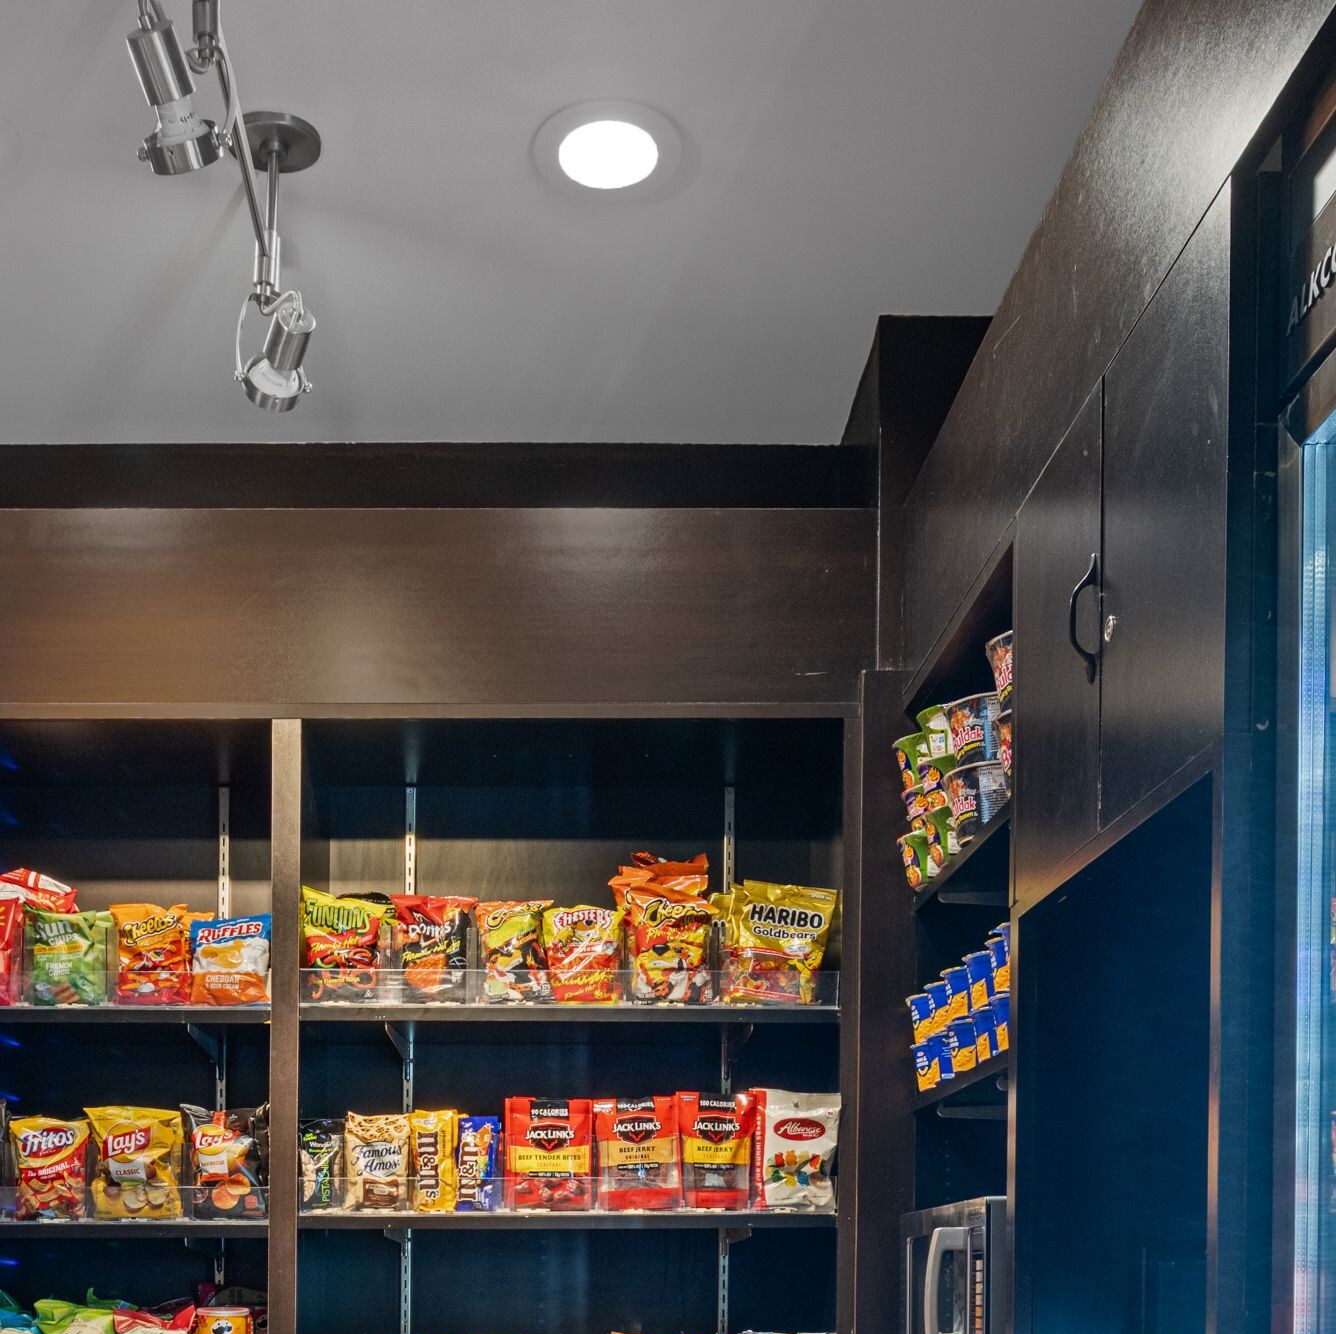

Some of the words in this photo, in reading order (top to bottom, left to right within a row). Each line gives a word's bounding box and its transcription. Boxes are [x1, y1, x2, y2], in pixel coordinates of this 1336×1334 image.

[304, 898, 371, 935] FUNYUNS
[750, 903, 824, 929] HARIBO
[35, 920, 73, 942] Sun
[123, 914, 176, 947] Cheetos
[197, 922, 262, 943] RUFFLES
[753, 926, 817, 940] Goldbears
[45, 962, 72, 970] FRENCH
[206, 975, 240, 983] CHEDDAR
[612, 1123, 635, 1133] JACK
[692, 1121, 714, 1131] JACK
[21, 1129, 74, 1157] Fritos
[107, 1129, 145, 1157] Lay's
[525, 1130, 547, 1140] JACK
[351, 1145, 401, 1166] Famous
[38, 1161, 70, 1176] ORIGINAL
[115, 1168, 141, 1176] CLASSIC
[357, 1159, 400, 1176] Amos
